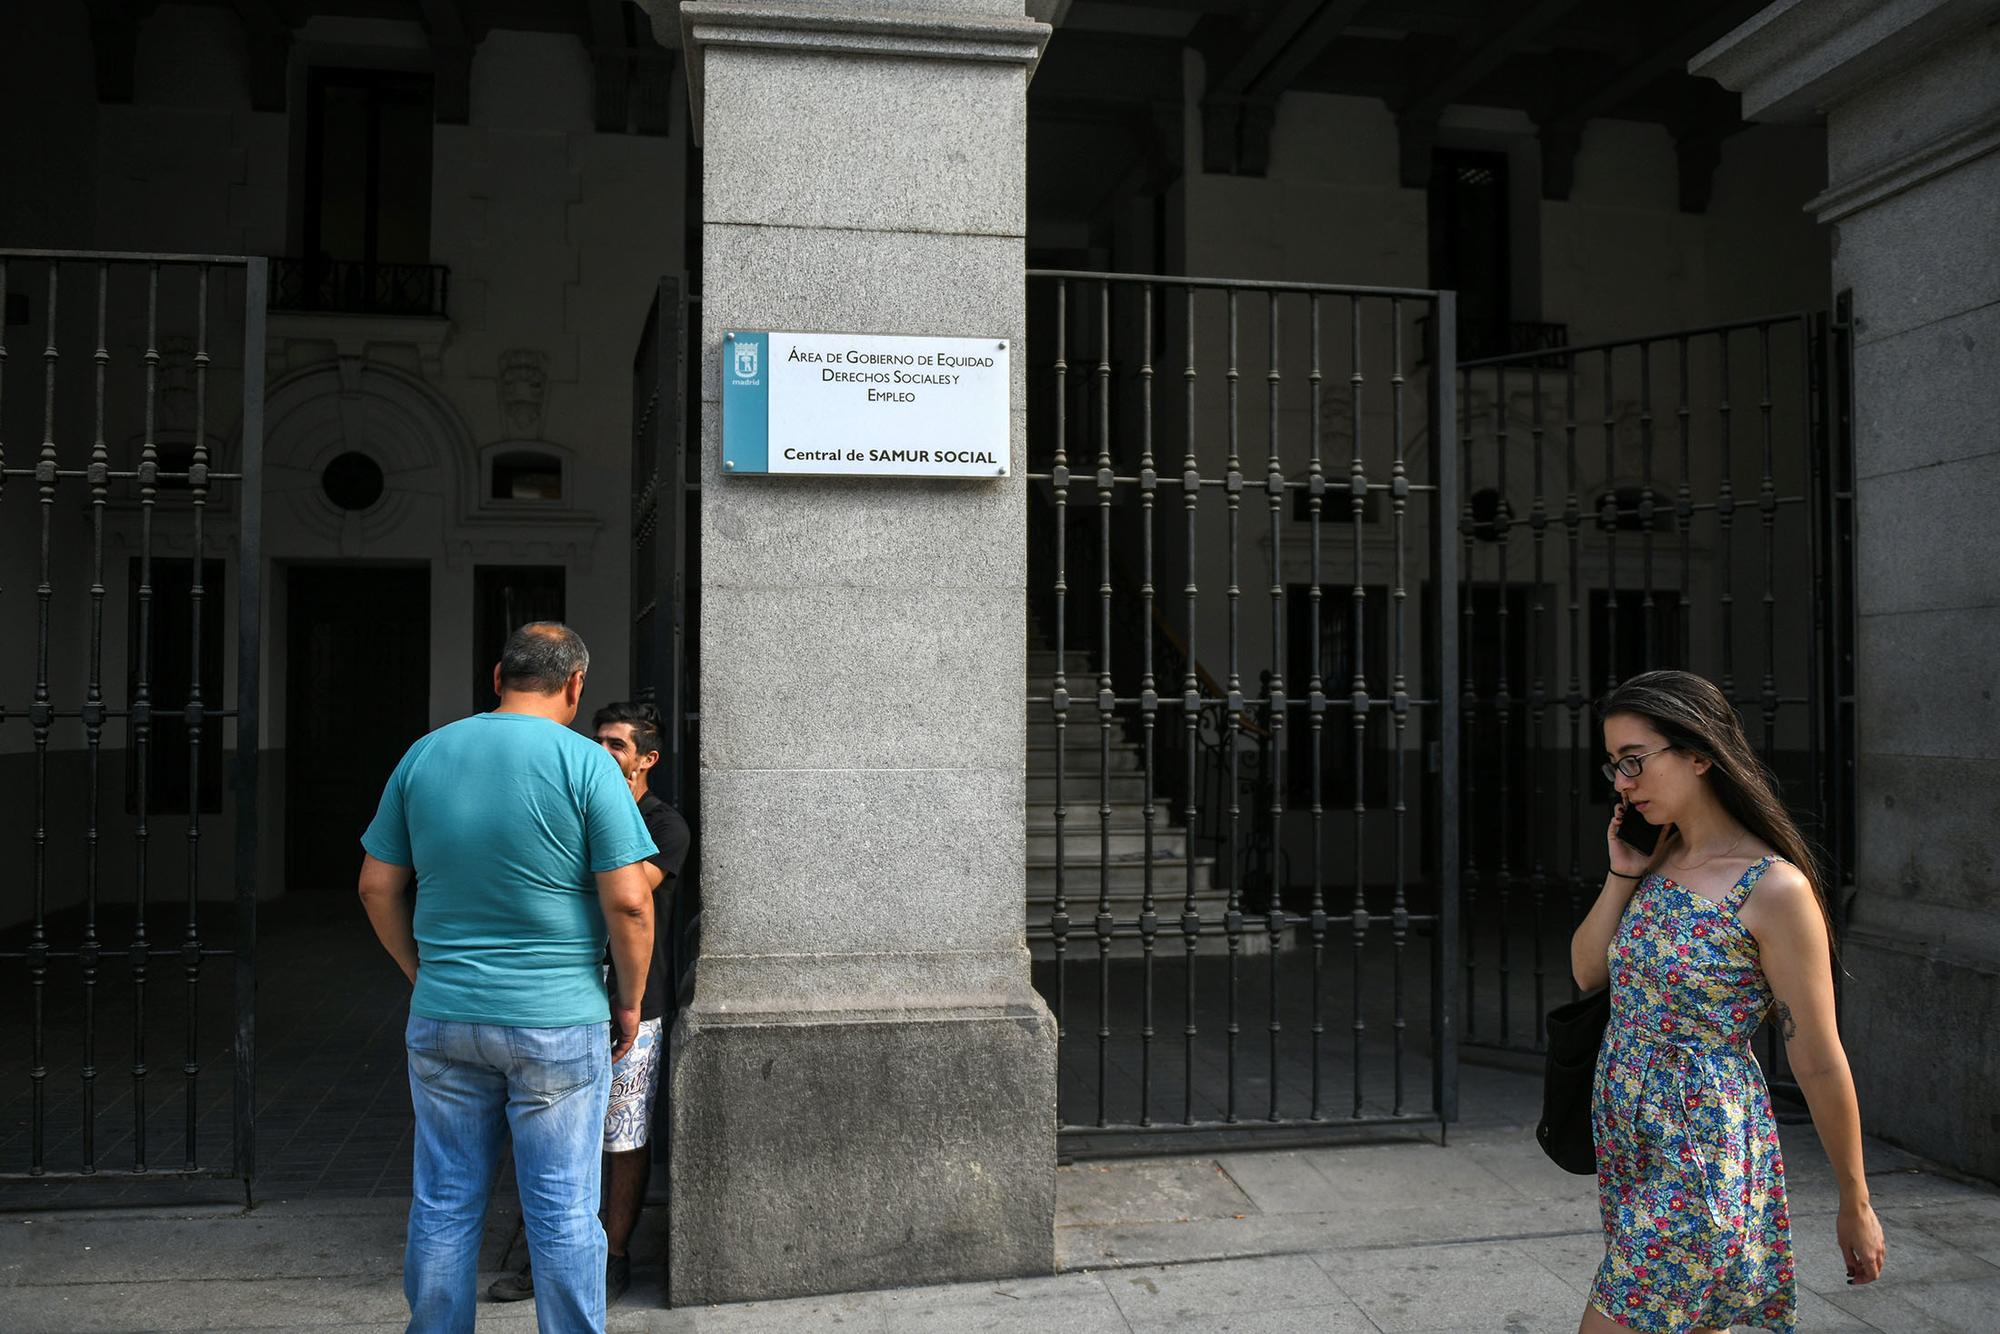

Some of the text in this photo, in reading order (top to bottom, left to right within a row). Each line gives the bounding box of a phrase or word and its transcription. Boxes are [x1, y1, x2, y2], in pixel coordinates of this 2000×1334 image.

[788, 346, 994, 367] ÁREA DE GOBIERNO DE EQUIDAD
[732, 378, 760, 386] madrid
[822, 369, 890, 383] DERECHOS
[868, 389, 916, 403] EMPLEO
[784, 448, 997, 464] Central de SAMUR SOCIAL
